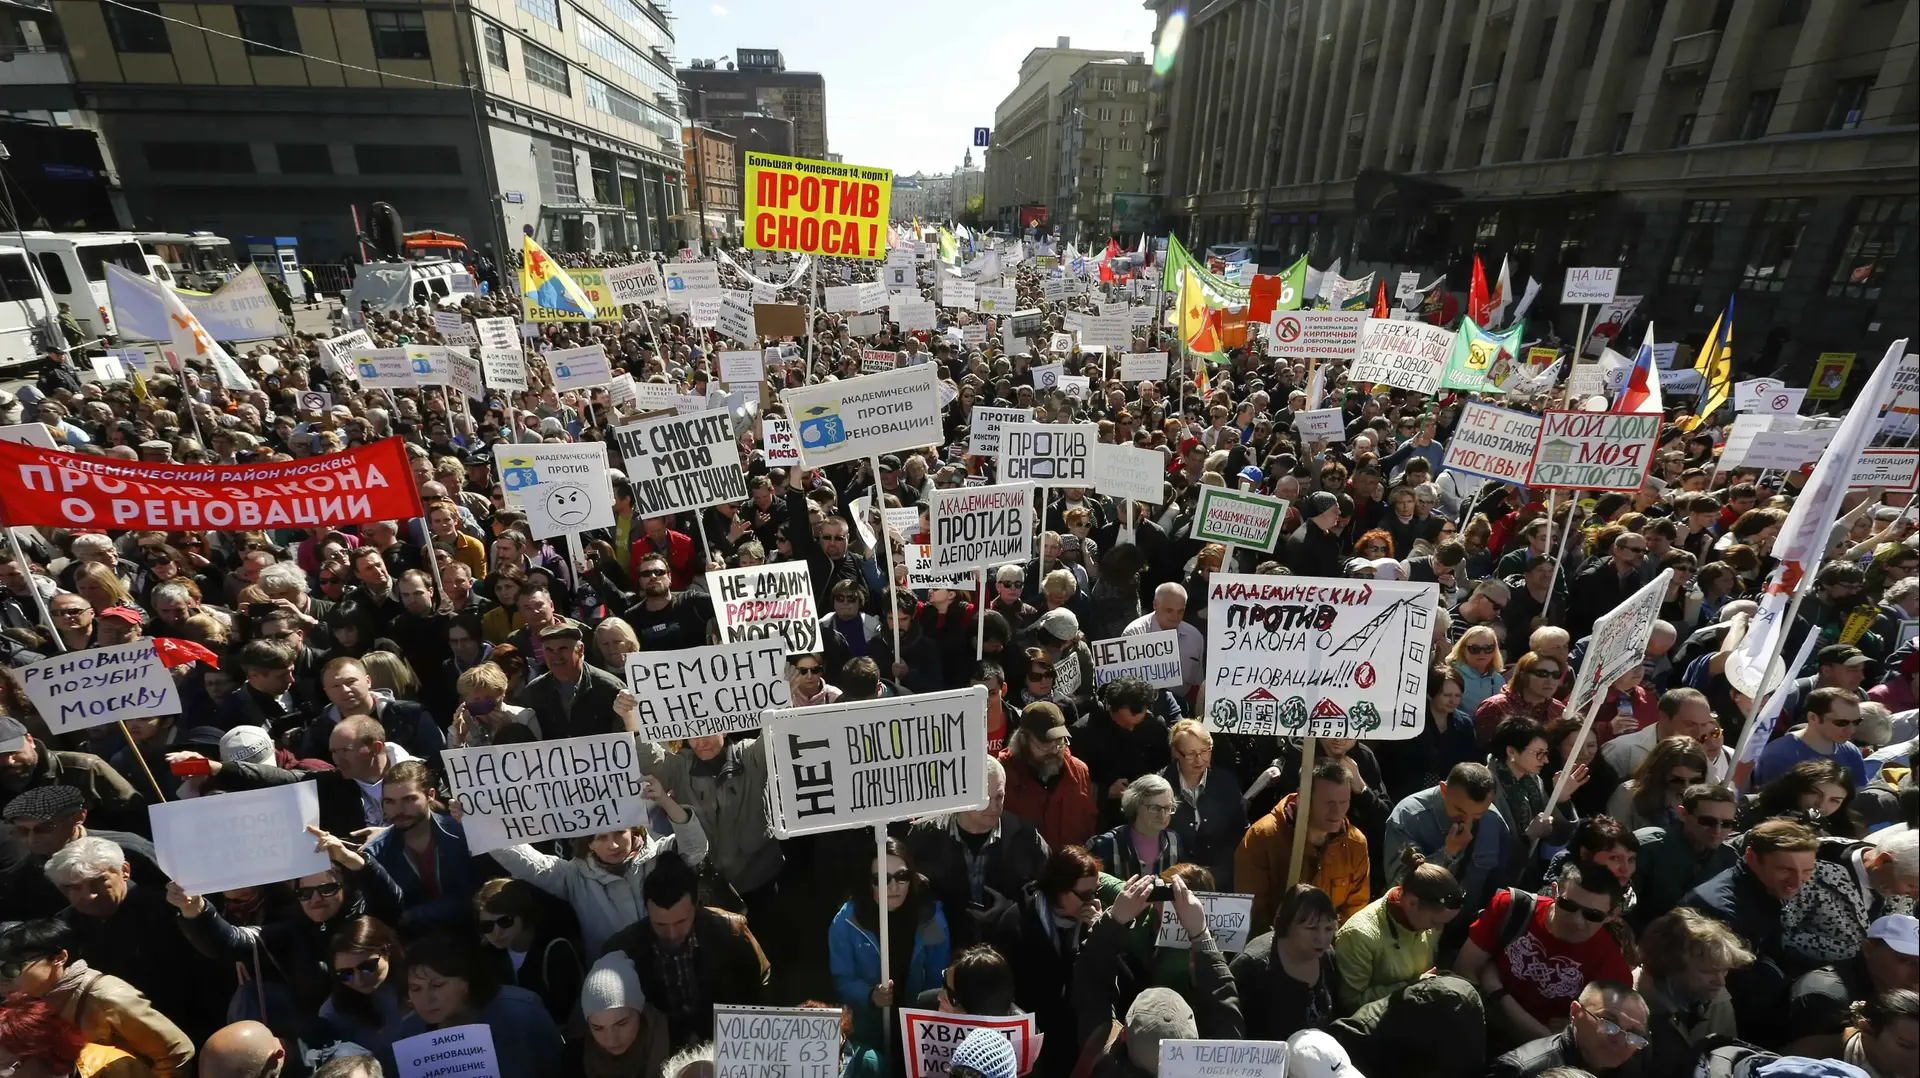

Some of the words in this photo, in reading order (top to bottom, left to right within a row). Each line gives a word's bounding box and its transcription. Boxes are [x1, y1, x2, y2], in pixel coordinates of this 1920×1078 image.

[748, 155, 793, 171] Большая
[795, 162, 848, 177] Филевская
[861, 172, 889, 182] корп.1
[757, 171, 880, 218] ПРОТИВ
[755, 213, 861, 256] СНОСА
[612, 273, 658, 294] ПРОТИВ
[1567, 290, 1610, 299] Останкино
[530, 307, 619, 320] РЕНОВАИИ
[326, 334, 368, 357] ИЗМАЙЛОВО
[1303, 331, 1358, 339] КИРПИЧНЫЙ
[1425, 330, 1450, 348] НАШ
[864, 350, 895, 362] ОСТАНКИНО
[1361, 334, 1417, 355] КИРПИЧНЫЙ
[1418, 342, 1446, 366] ХРУЩ
[1359, 351, 1382, 366] ВАС
[1382, 354, 1392, 366] С
[1393, 354, 1434, 376] ВОВОЙ
[841, 382, 931, 406] АКАДЕМИЧЕСКИЙ
[858, 401, 913, 420] ПРОТИВ
[979, 411, 1026, 423] ПРОТИВ
[1463, 406, 1504, 431] НЕТ
[616, 429, 648, 459] НЕ
[649, 412, 734, 453] СНОСИТЕ
[845, 415, 934, 441] РЕНОВАЦИИ!
[1310, 422, 1328, 430] НЕТ
[1544, 413, 1609, 439] МОЙ
[1604, 415, 1661, 443] ДОМ
[535, 453, 602, 462] АКАДЕМИЧЕСКИЙ
[980, 444, 999, 453] зак
[1008, 432, 1088, 458] ПРОТИВ
[1576, 442, 1647, 468] МОЯ
[38, 455, 216, 483] АКАДЕМИЧЕСКИЙ
[220, 469, 281, 483] РАЙОН
[284, 455, 356, 477] МОСКВЫ
[547, 465, 591, 477] ПРОТИВ
[652, 446, 713, 477] МОЮ
[1007, 458, 1086, 480] СНОСА
[1449, 447, 1531, 481] МОСКВЫ!
[1857, 458, 1915, 466] РЕНОВАЦИЯ
[20, 464, 211, 499] ПРОТИВ
[223, 463, 389, 499] ЗАКОНА
[1532, 464, 1643, 487] КРЕПОСТЬ
[1851, 474, 1912, 482] ДЕПОРТАЦИЯ
[631, 463, 747, 515] КОНСТИТУЦИЮ
[62, 497, 95, 524] О
[112, 494, 373, 526] РЕНОВАЦИИ
[938, 490, 1025, 517] АКАДЕМИЧЕСКИЙ
[1211, 499, 1273, 517] СОХРАНИМ
[938, 509, 1023, 546] ПРОТИВ
[1207, 508, 1271, 529] АКАДЕМИЧЕСКИЙ
[938, 536, 1023, 567] ДЕПОРТАЦИИ
[719, 573, 749, 603] НЕ
[755, 570, 811, 600] ДАДИМ
[1211, 583, 1373, 606] АКАДЕМИЧЕСКИЙ
[726, 598, 811, 626] РАЗРУШИТЬ
[1227, 603, 1338, 633] ПРОТИВ
[727, 618, 817, 652] МОСКВУ
[1220, 629, 1306, 654] ЗАКОНА
[1316, 631, 1334, 652] О
[1094, 640, 1128, 667] НЕТ
[1127, 641, 1175, 665] СНОСУ
[631, 647, 783, 695] РЕМОНТ
[1216, 660, 1355, 690] РЕНОВАЦИИ!!!
[638, 700, 660, 725] А
[667, 690, 710, 722] НЕ
[714, 679, 788, 714] СНОС
[845, 711, 967, 766] ВЫСОТНЫМ
[448, 740, 632, 790] НАСИЛЬНО
[788, 733, 835, 820] НЕТ
[457, 771, 642, 816] ОСЧАСТЛИВИТЬ
[850, 756, 969, 812] ДЖУНГЛЯМ!
[500, 798, 622, 841] НЕЛЬЗЯ!
[431, 1032, 466, 1047] ЗАКОН
[800, 1041, 829, 1063] 63
[413, 1058, 422, 1068] О
[1165, 1045, 1186, 1062] ЗА
[1193, 1044, 1287, 1068] ТЕЛЕПОРТАЦИЮ
[1199, 1065, 1263, 1078] ЛОББИСТОВ
